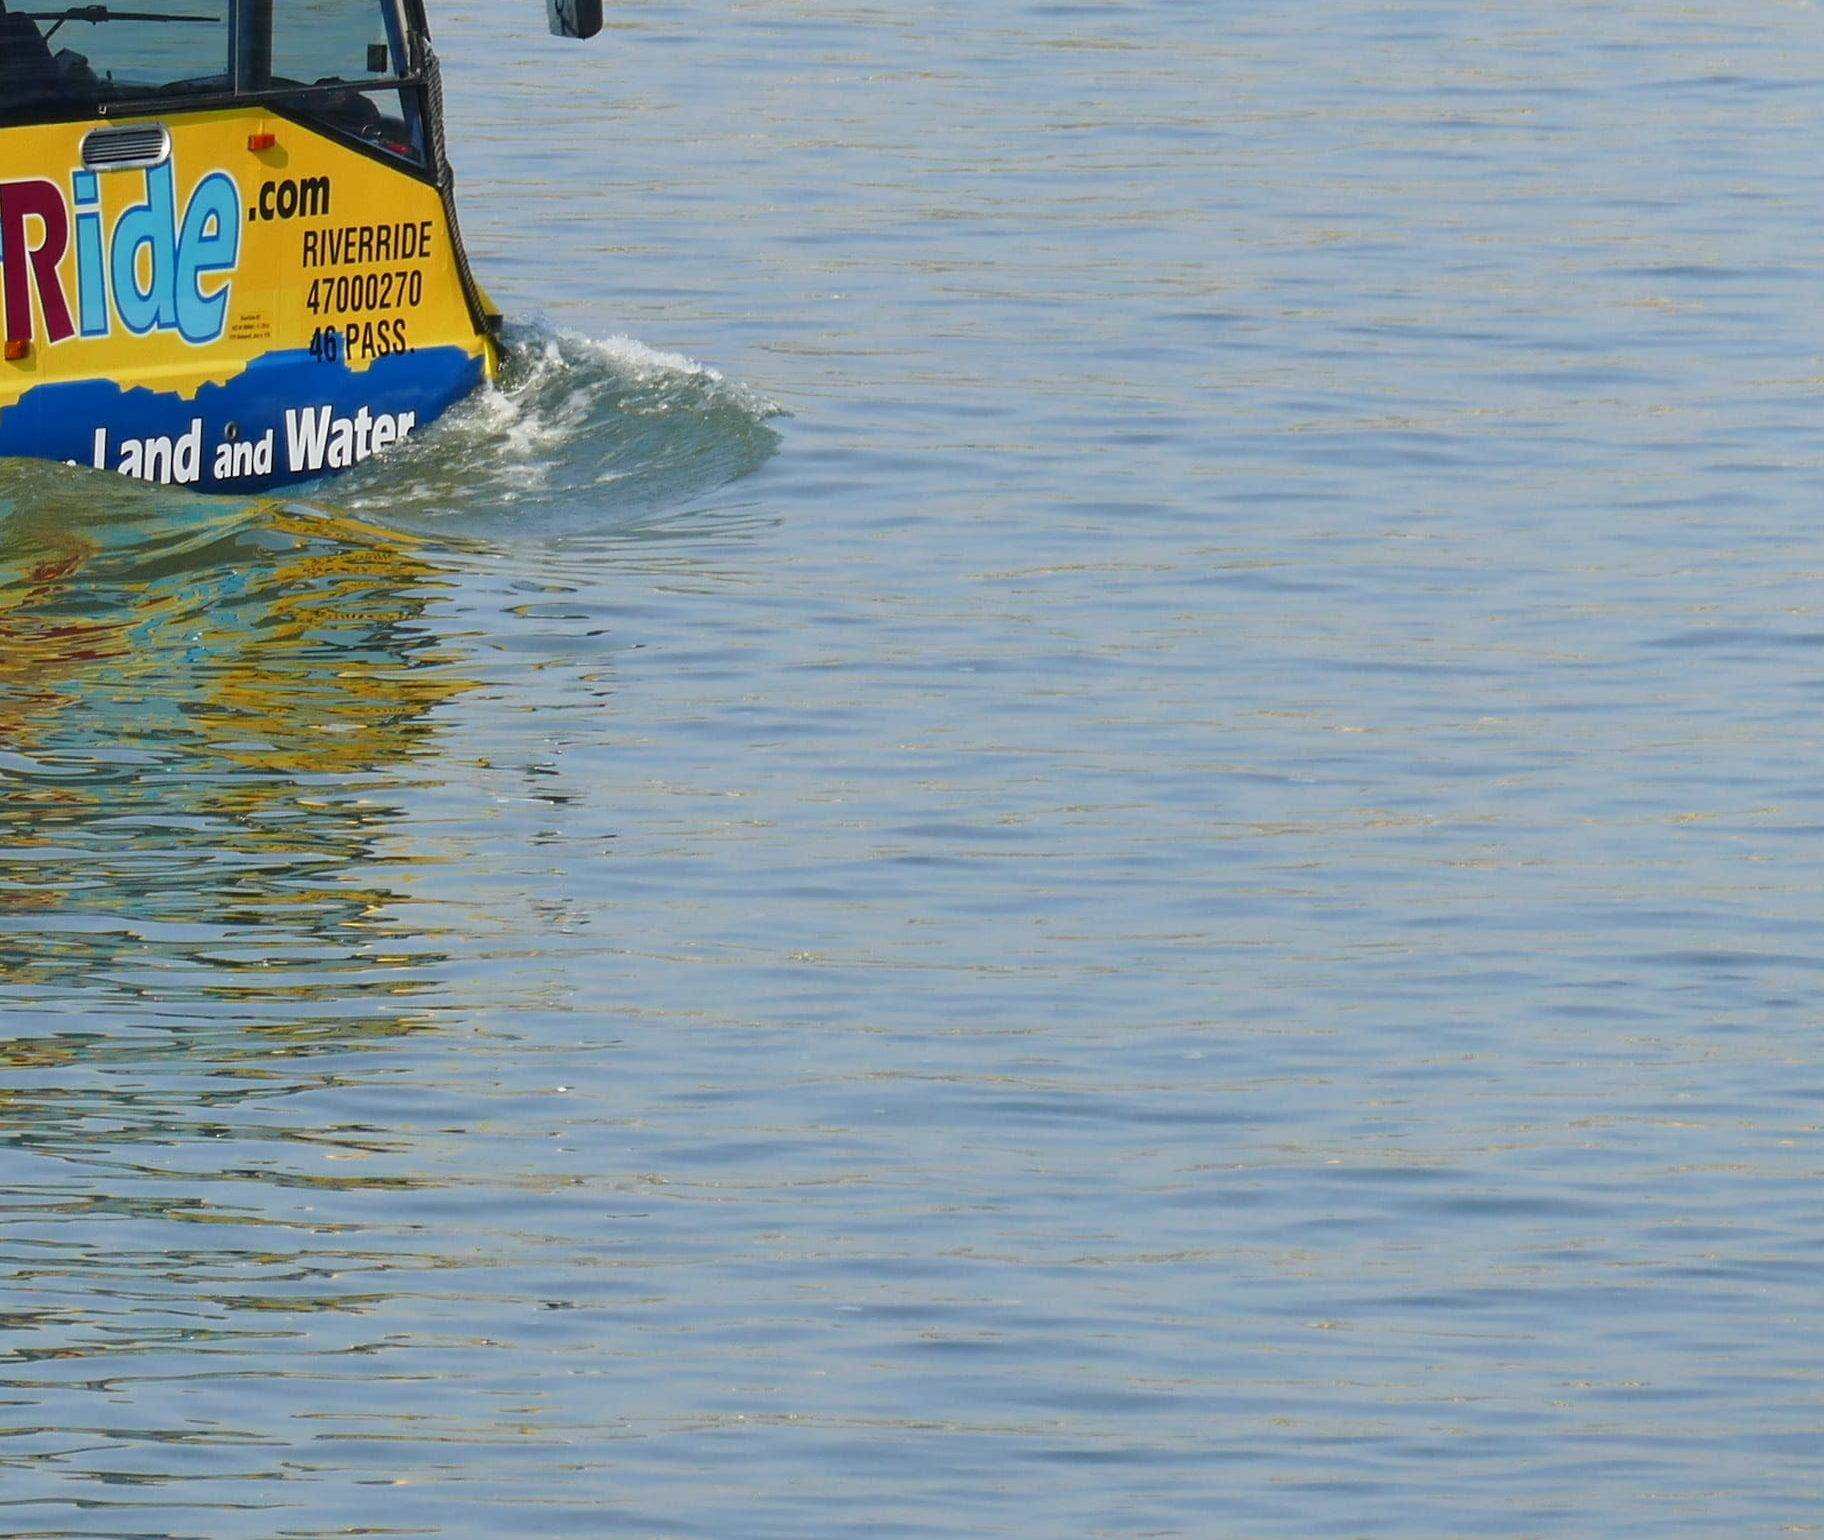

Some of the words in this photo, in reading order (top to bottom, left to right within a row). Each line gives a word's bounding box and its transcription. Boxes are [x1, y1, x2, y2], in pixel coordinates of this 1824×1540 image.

[302, 220, 433, 268] RIVERRIDE
[306, 269, 423, 316] 47000270
[309, 324, 338, 363] 46
[344, 318, 415, 360] PASS.
[92, 418, 203, 485] Land
[213, 428, 275, 480] and
